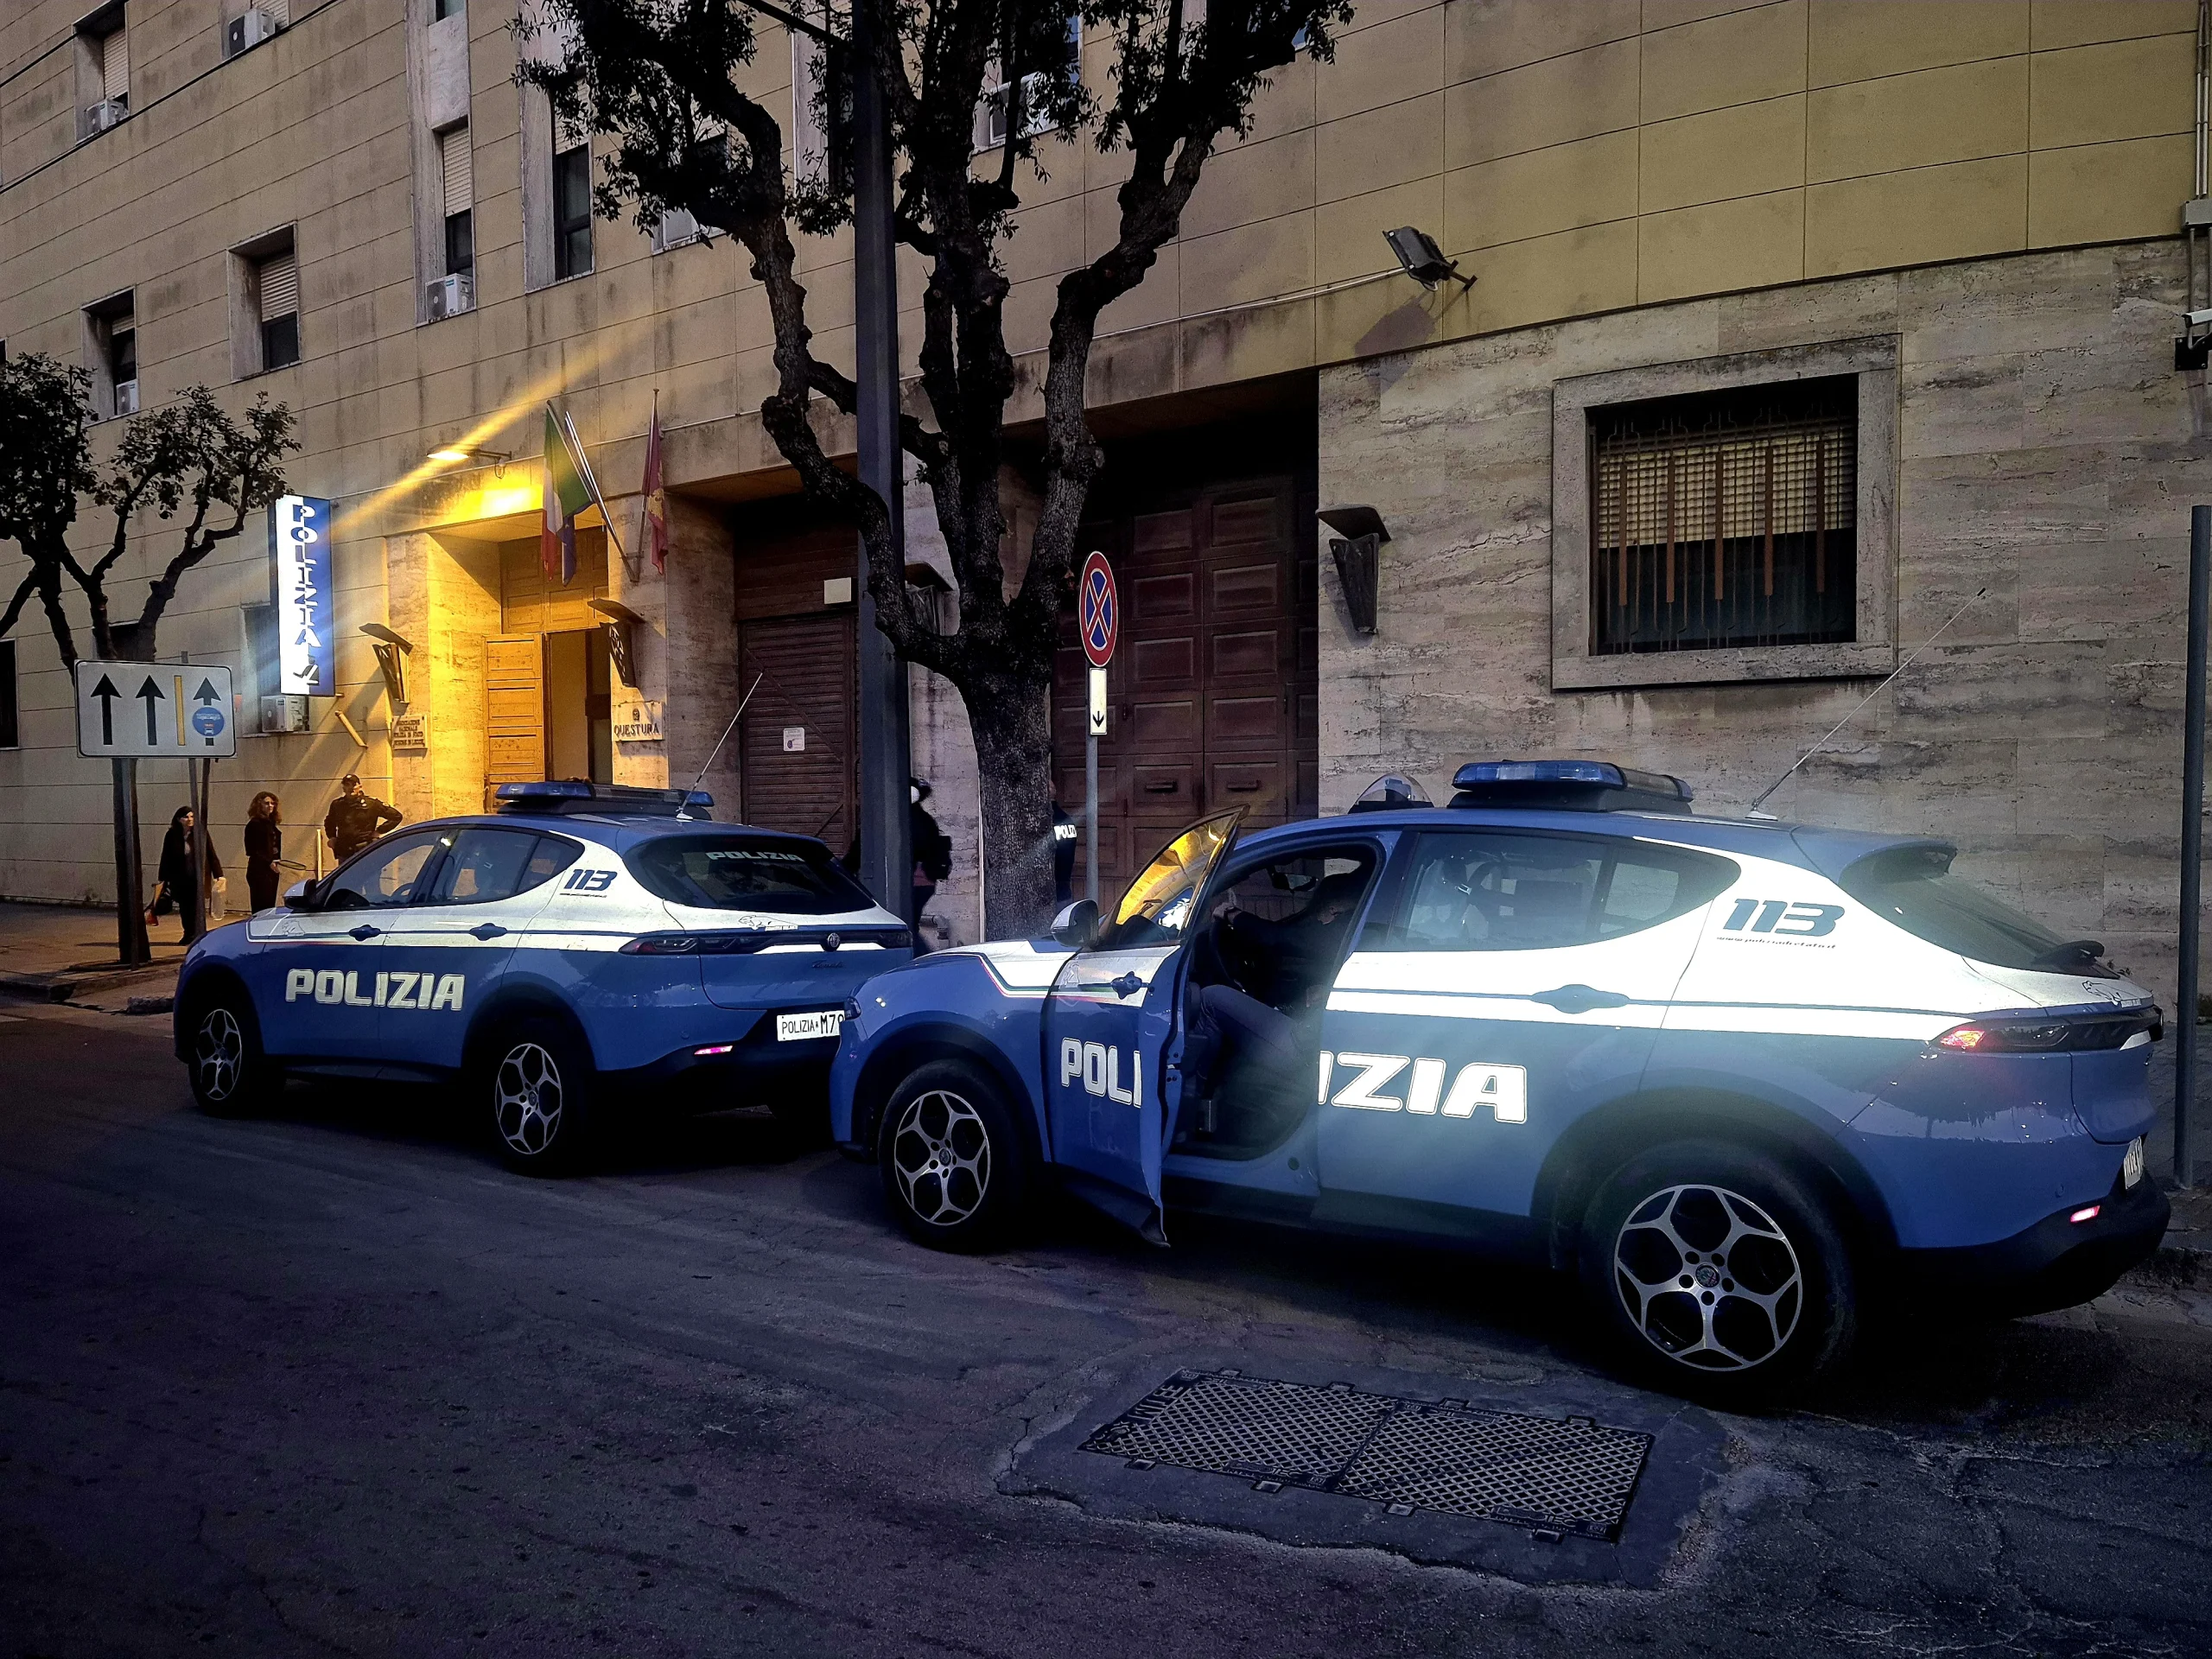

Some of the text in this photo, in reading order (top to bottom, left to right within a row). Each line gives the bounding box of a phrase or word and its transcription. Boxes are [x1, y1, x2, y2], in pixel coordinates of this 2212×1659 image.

[290, 504, 321, 647] POLIZIA
[613, 723, 659, 738] QUESTURA
[705, 851, 805, 862] POLIZIA
[563, 868, 618, 891] 113
[1722, 898, 1846, 937] 113
[285, 969, 466, 1011] POLIZIA
[781, 1020, 815, 1035] POLIZIA
